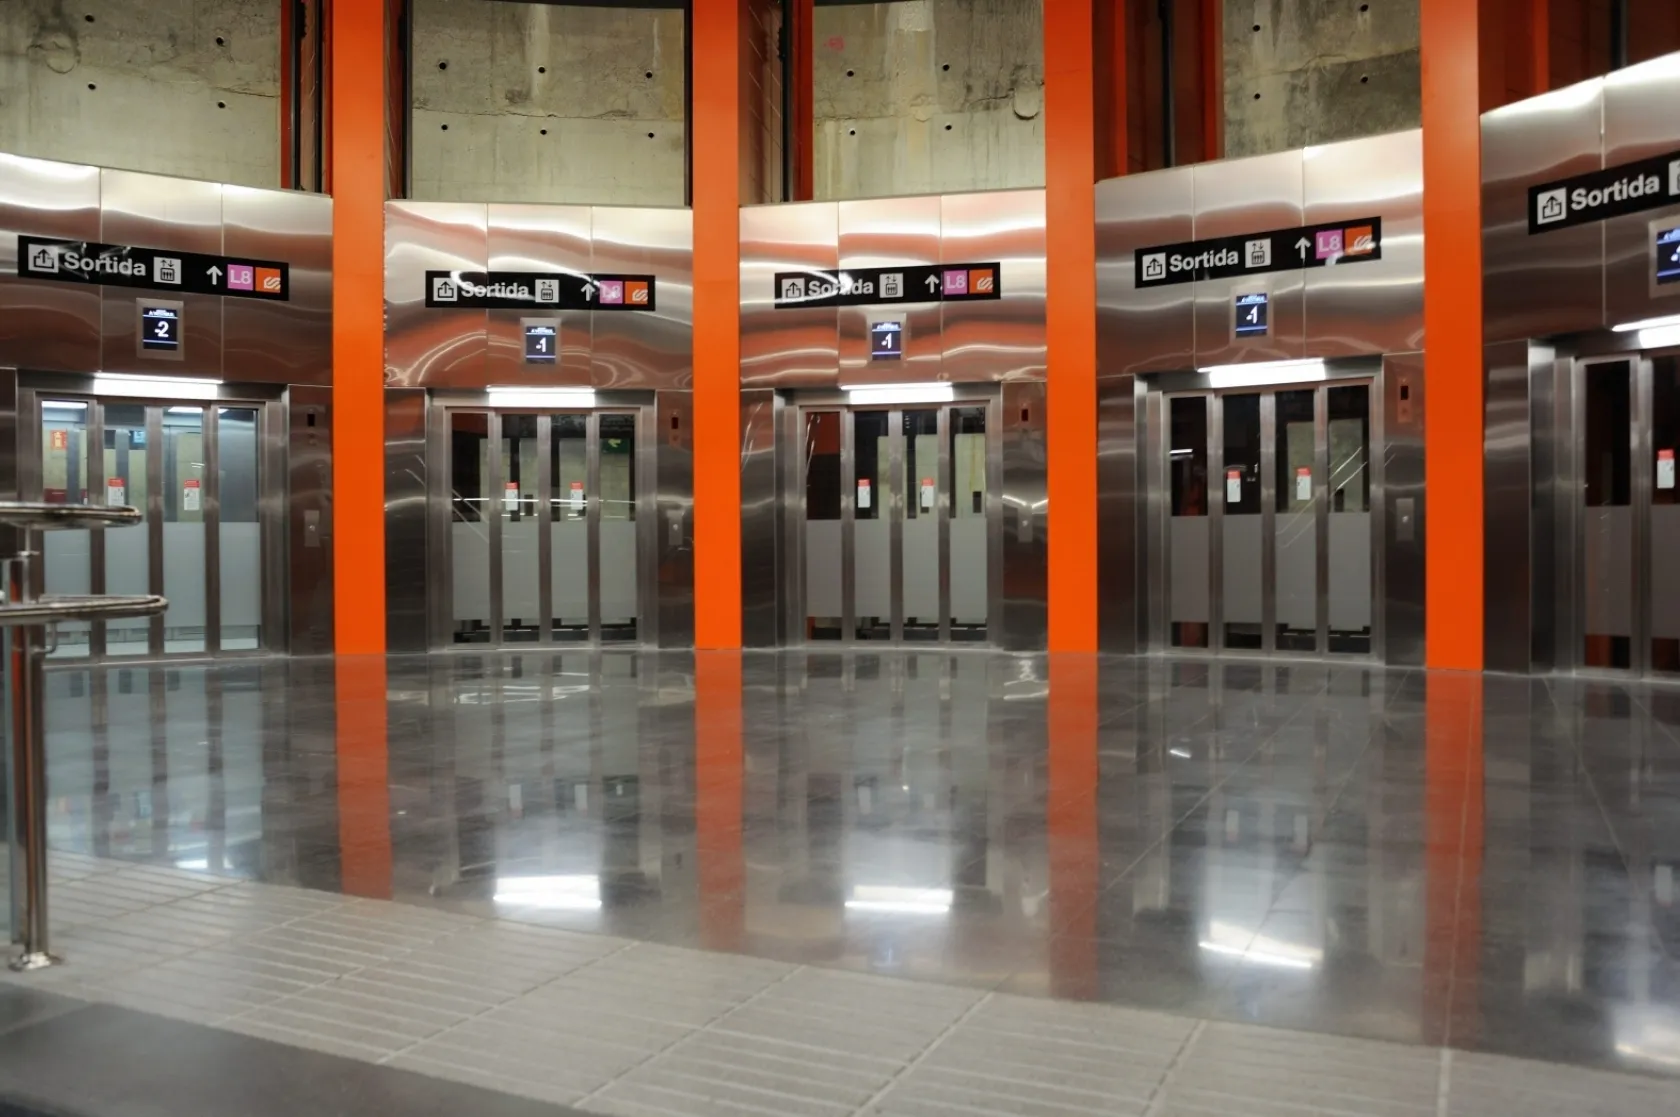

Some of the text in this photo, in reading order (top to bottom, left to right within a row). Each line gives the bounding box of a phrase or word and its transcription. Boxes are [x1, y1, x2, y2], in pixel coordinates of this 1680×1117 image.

[1571, 173, 1660, 211] Sortida
[64, 251, 252, 285] Sortida L8
[1169, 235, 1341, 272] Sortida L8
[461, 281, 529, 299] Sortida
[946, 274, 966, 289] L8
